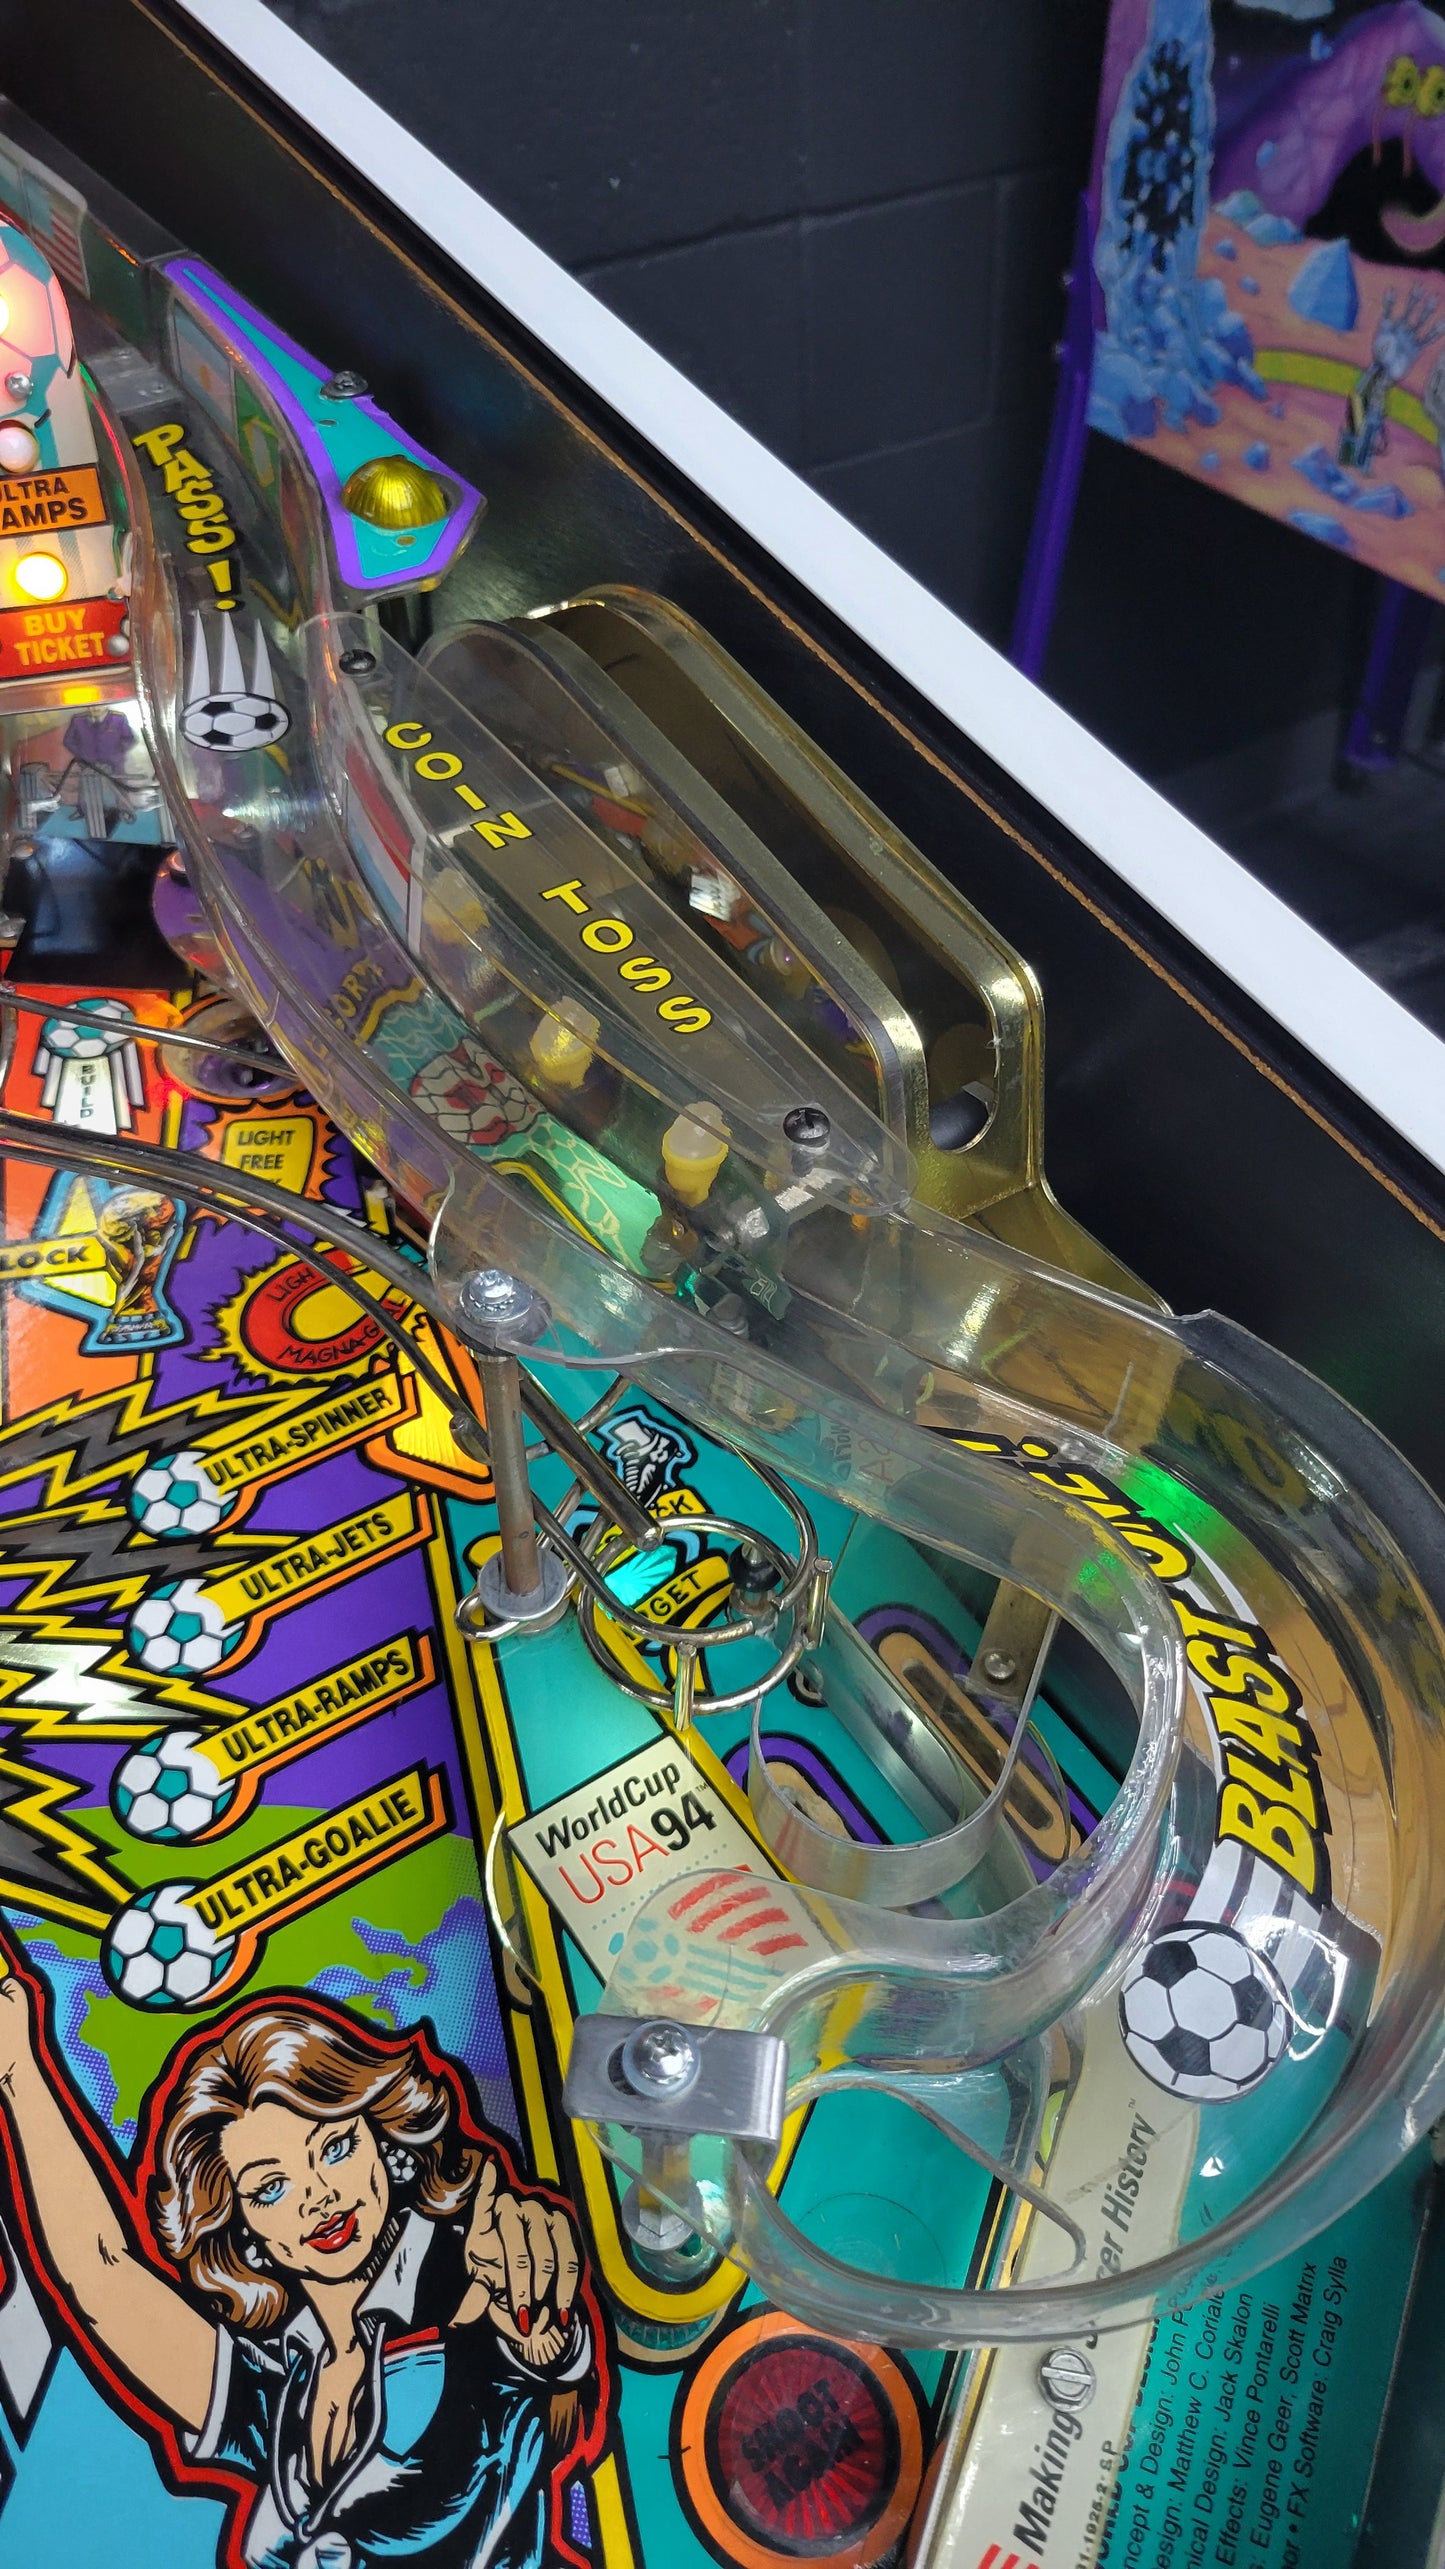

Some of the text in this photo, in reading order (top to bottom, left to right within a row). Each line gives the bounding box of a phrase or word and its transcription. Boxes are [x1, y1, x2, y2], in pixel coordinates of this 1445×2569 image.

[0, 477, 70, 501] LTRA
[132, 423, 237, 611] PASS!
[15, 632, 105, 665] TICKET
[24, 608, 88, 637] BUY
[385, 721, 713, 1034] COIN TOSS
[80, 1064, 96, 1118] BUILD
[237, 1129, 296, 1146] LIGHT
[240, 1153, 285, 1170] FREE
[0, 1245, 90, 1271] LOCK
[266, 1267, 317, 1303] LIGH
[277, 1298, 408, 1365] MAGNA-GAL
[204, 1387, 395, 1488] ULTRA-SPINNER
[241, 1511, 395, 1602] ULTRA-JETS
[220, 1647, 411, 1764] ULTRA-RAMPS
[1170, 1597, 1322, 1898] BLAST
[534, 1762, 681, 1859] WorldCup
[194, 1788, 419, 1930] ULTRA-GOALIE
[1289, 2260, 1318, 2326] Matrix
[1321, 2254, 1349, 2306] Sylla
[1013, 2410, 1084, 2557] Making
[1101, 2111, 1157, 2233] History
[1161, 2331, 1187, 2386] John
[1223, 2292, 1254, 2365] Skalon
[1279, 2328, 1306, 2386] Scott
[1312, 2308, 1343, 2369] Craig
[1213, 2369, 1240, 2422] Jack
[1267, 2394, 1298, 2453] Geer,
[1293, 2372, 1329, 2479] Software:
[1140, 2389, 1174, 2476] Design:
[1167, 2397, 1203, 2493] Matthew
[1189, 2369, 1211, 2392] C.
[1215, 2301, 1281, 2568] Effects: Vince Pontarelli
[1136, 2482, 1155, 2500] &
[1194, 2426, 1228, 2514] Design:
[1286, 2480, 1311, 2520] FX
[1250, 2458, 1284, 2550] Eugene
